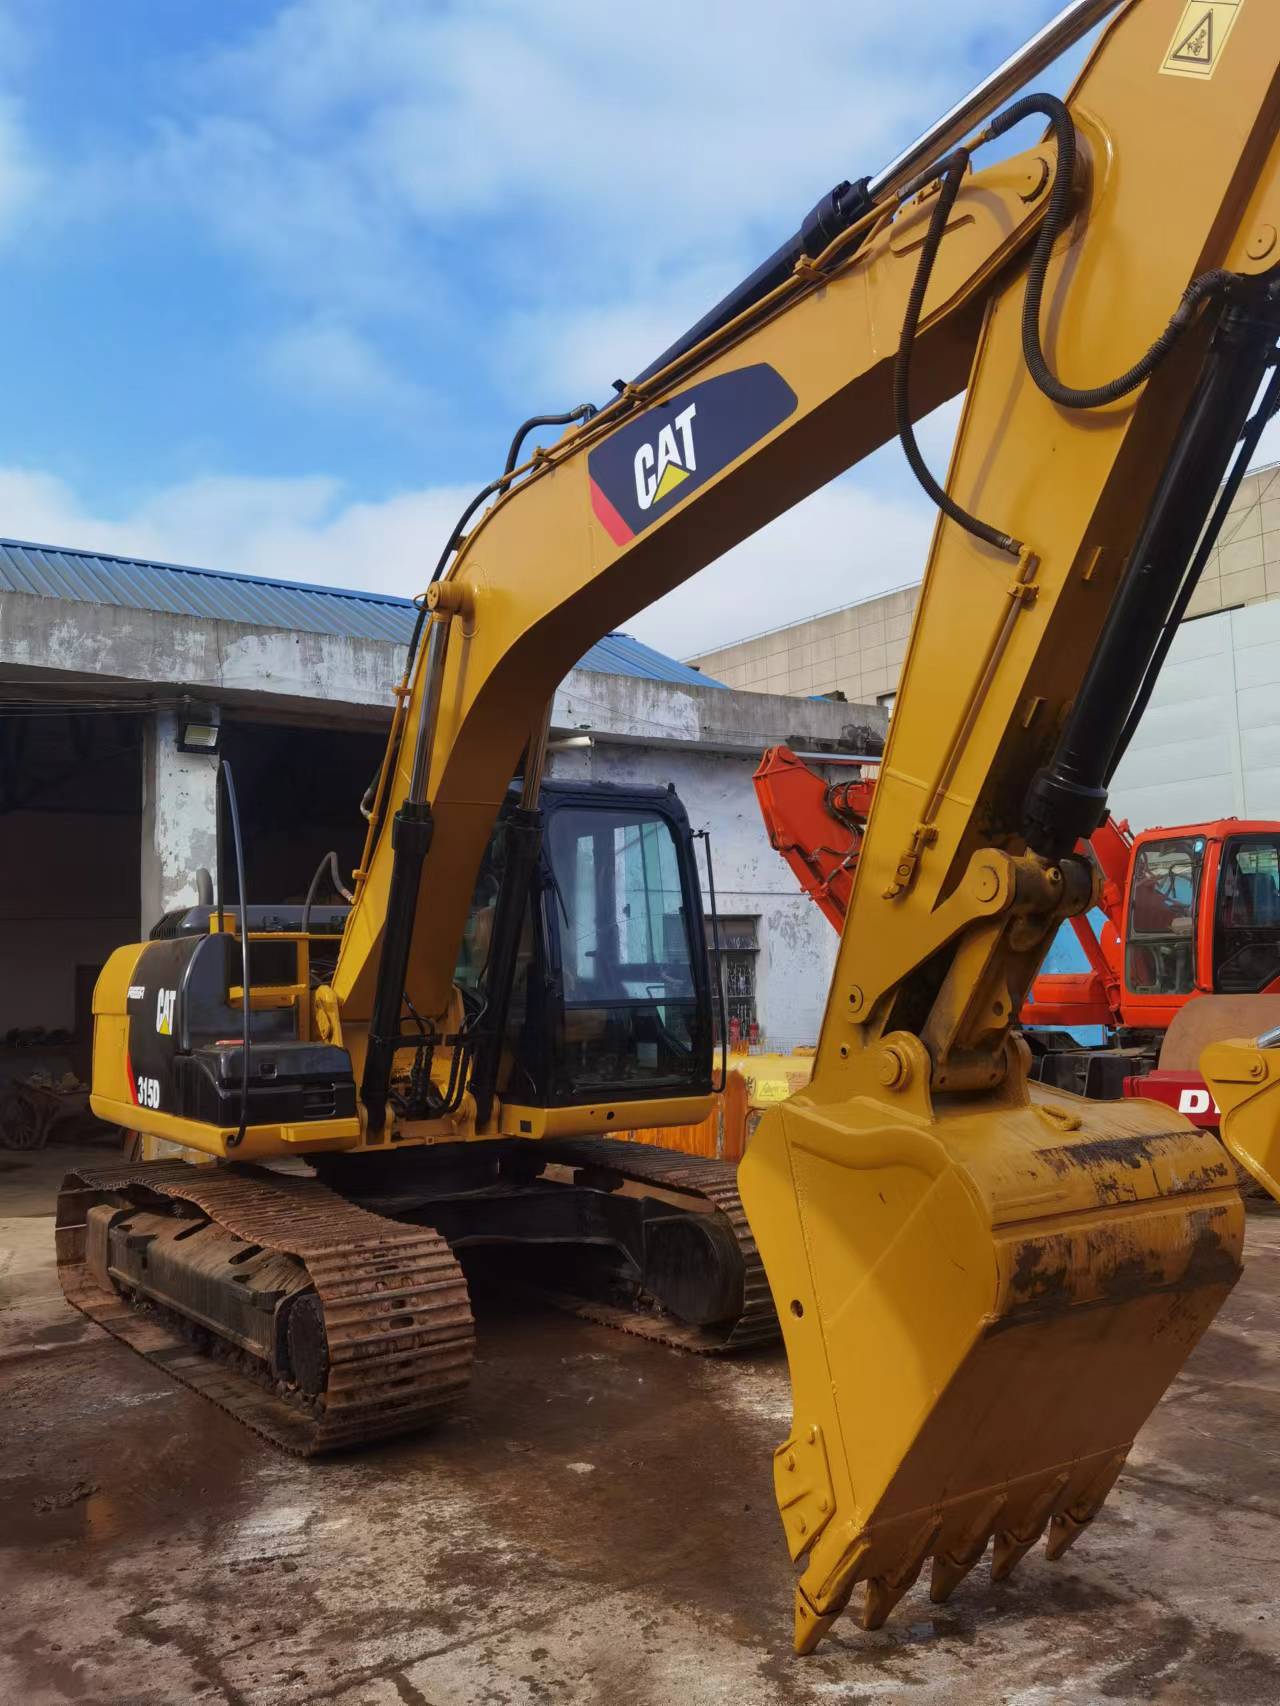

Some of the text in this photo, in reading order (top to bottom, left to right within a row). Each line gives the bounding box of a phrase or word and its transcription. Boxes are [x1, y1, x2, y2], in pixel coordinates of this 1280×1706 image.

[633, 402, 697, 510] CAT
[156, 987, 177, 1035] CAT
[137, 1075, 160, 1109] 315D
[1178, 1089, 1222, 1114] D
